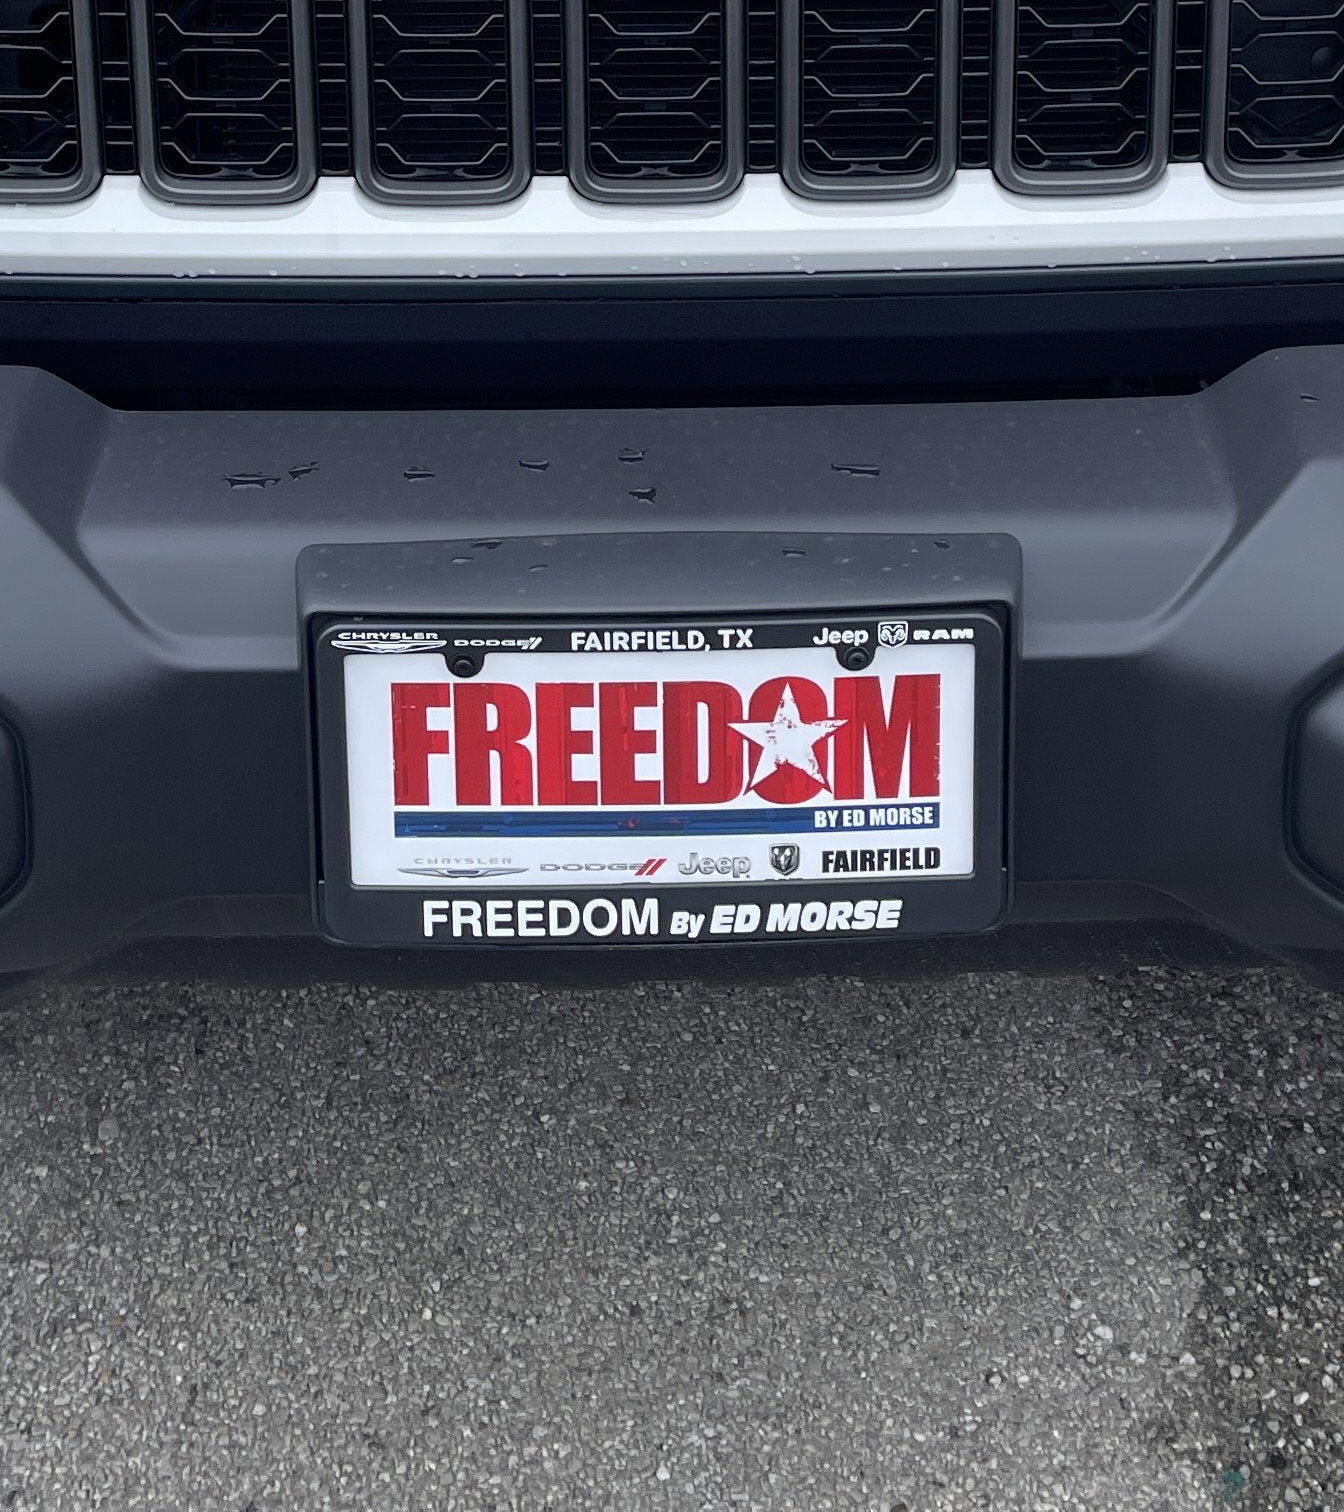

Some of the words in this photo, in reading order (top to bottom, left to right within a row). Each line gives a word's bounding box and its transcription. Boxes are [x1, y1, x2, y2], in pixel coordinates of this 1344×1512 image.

[337, 631, 439, 641] CHRYSLER
[453, 638, 530, 648] DODGE
[570, 628, 711, 652] FAIRFIELD,
[717, 628, 754, 648] TX
[812, 627, 870, 647] Jeep
[912, 628, 974, 641] RAM
[391, 674, 941, 807] FREEDOM
[814, 810, 838, 829] BY
[842, 809, 864, 827] ED
[869, 806, 934, 826] MORSE
[413, 856, 513, 866] CHRYSLER
[678, 852, 751, 878] Jeep
[821, 846, 941, 874] FAIRFIELD
[422, 897, 659, 938] FREEDOM
[669, 910, 705, 938] By
[709, 904, 761, 934] ED
[765, 899, 904, 933] MORSE
